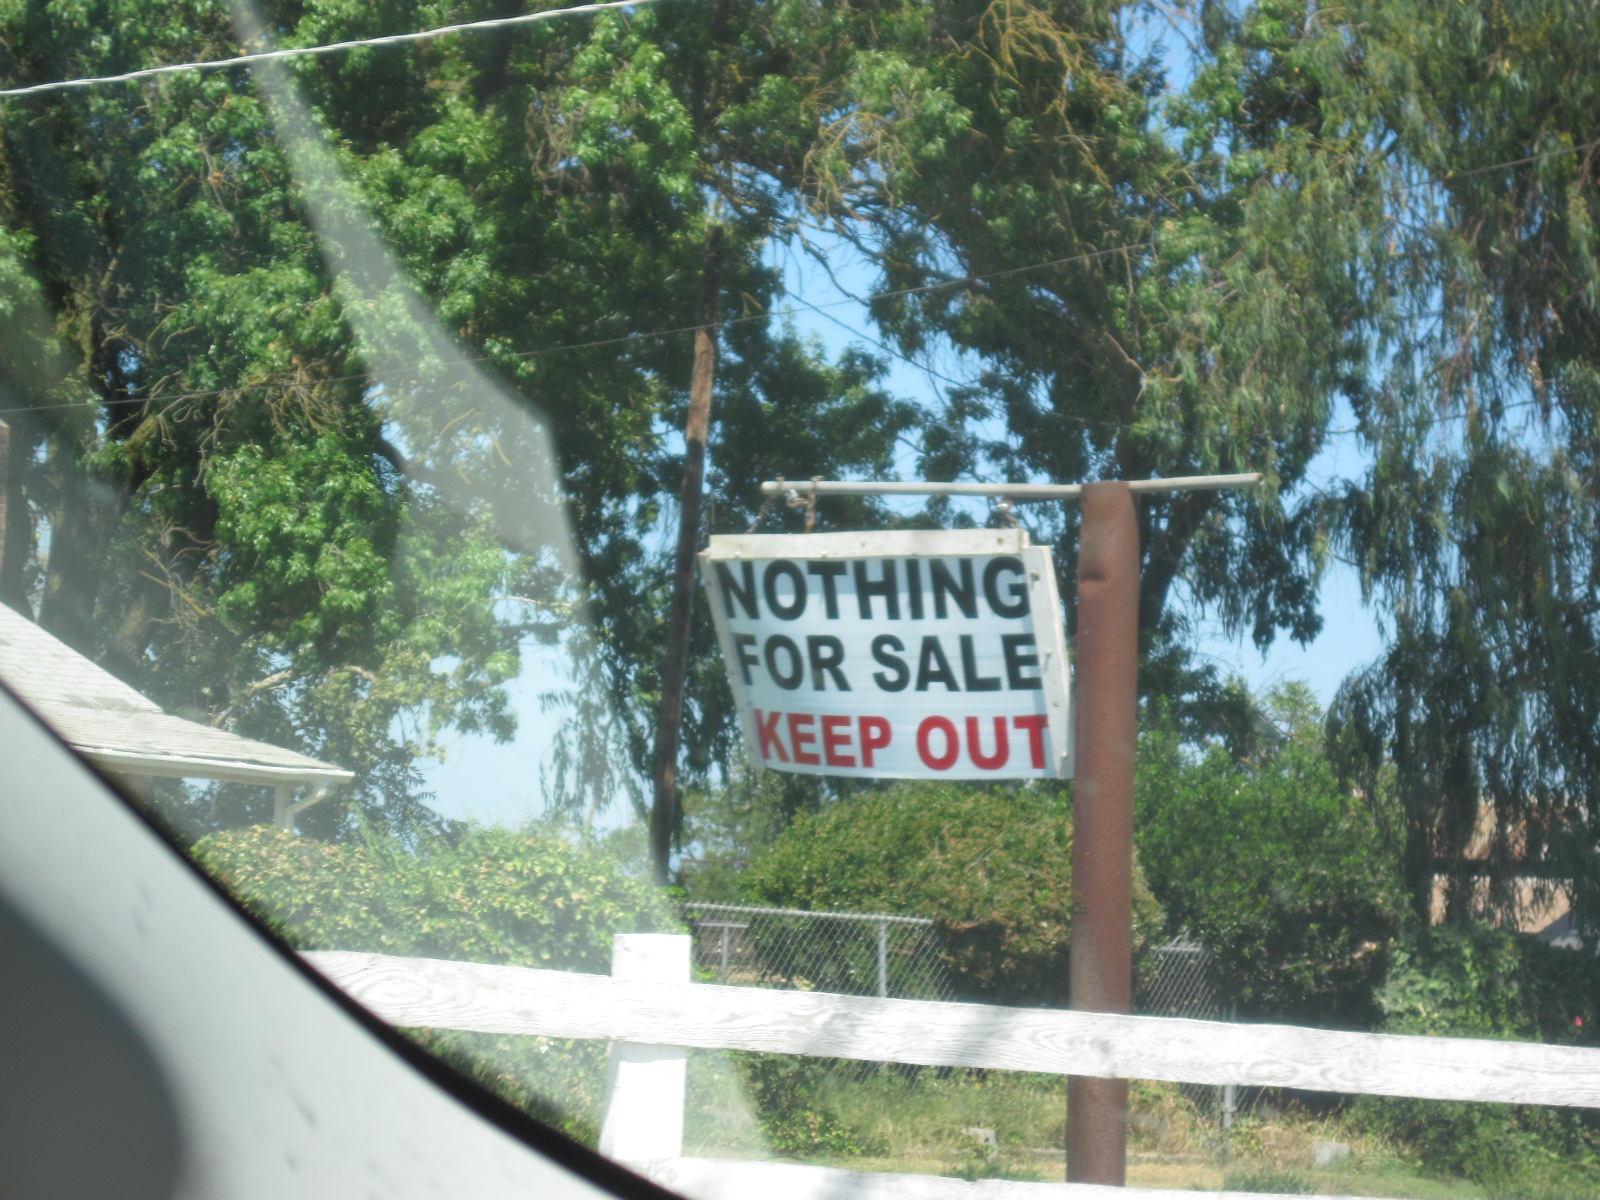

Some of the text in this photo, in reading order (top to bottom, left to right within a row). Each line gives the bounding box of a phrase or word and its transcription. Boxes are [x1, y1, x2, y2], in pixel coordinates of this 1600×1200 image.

[715, 556, 1031, 621] NOTHING
[732, 633, 1043, 692] FOR SALE
[753, 708, 1048, 771] KEEP OUT
